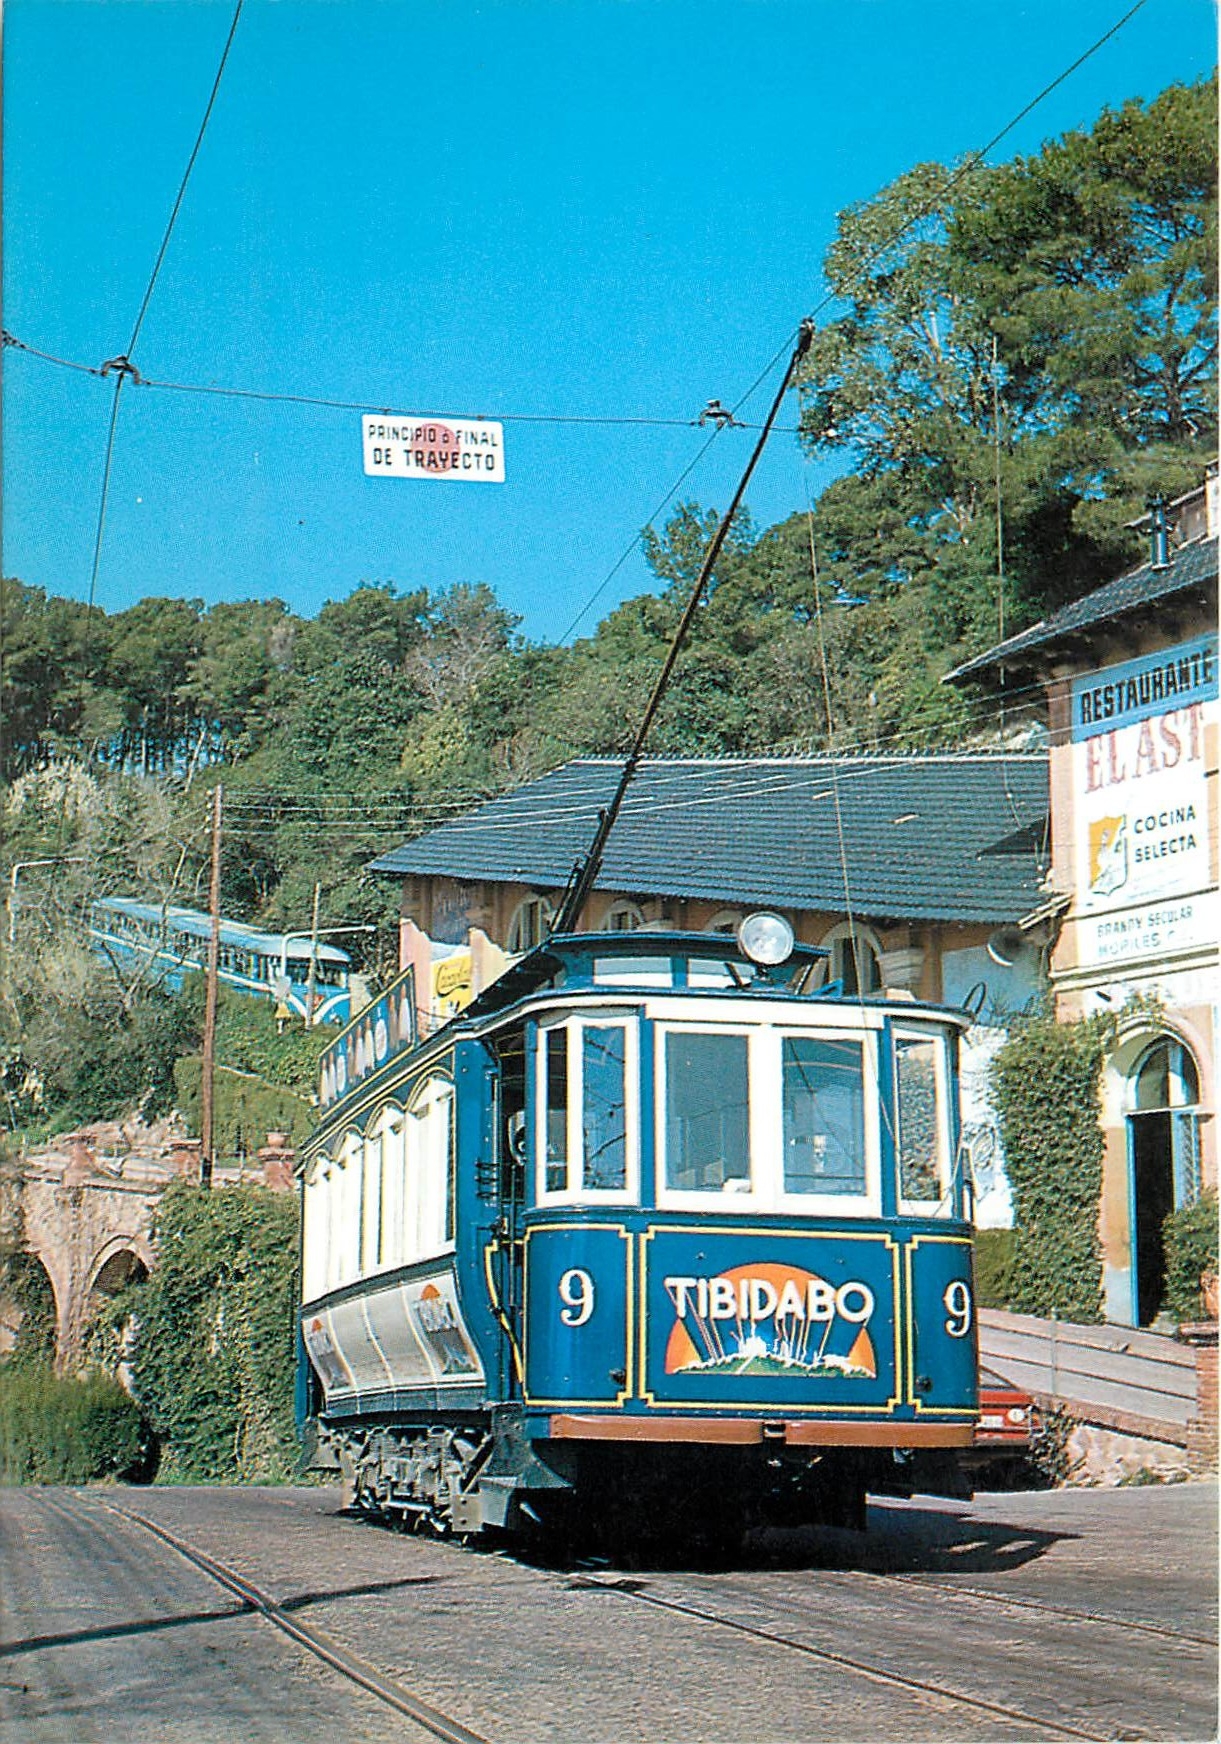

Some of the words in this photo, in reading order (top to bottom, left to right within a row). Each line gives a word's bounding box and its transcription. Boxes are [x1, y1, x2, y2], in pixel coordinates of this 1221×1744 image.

[368, 424, 437, 443] PRINCIPIO
[455, 430, 498, 447] FINAL
[373, 448, 393, 466] DE
[403, 449, 495, 471] TRAYECTO
[1081, 648, 1214, 724] RESTAURANTE
[1084, 728, 1126, 794] EL
[1131, 701, 1204, 779] AST
[1133, 804, 1197, 834] COCINA
[1135, 834, 1197, 863] SELECTA
[1147, 906, 1193, 927] SECULAR
[558, 1268, 595, 1327] 9
[664, 1276, 875, 1324] TIBIDABO
[943, 1281, 973, 1338] 9
